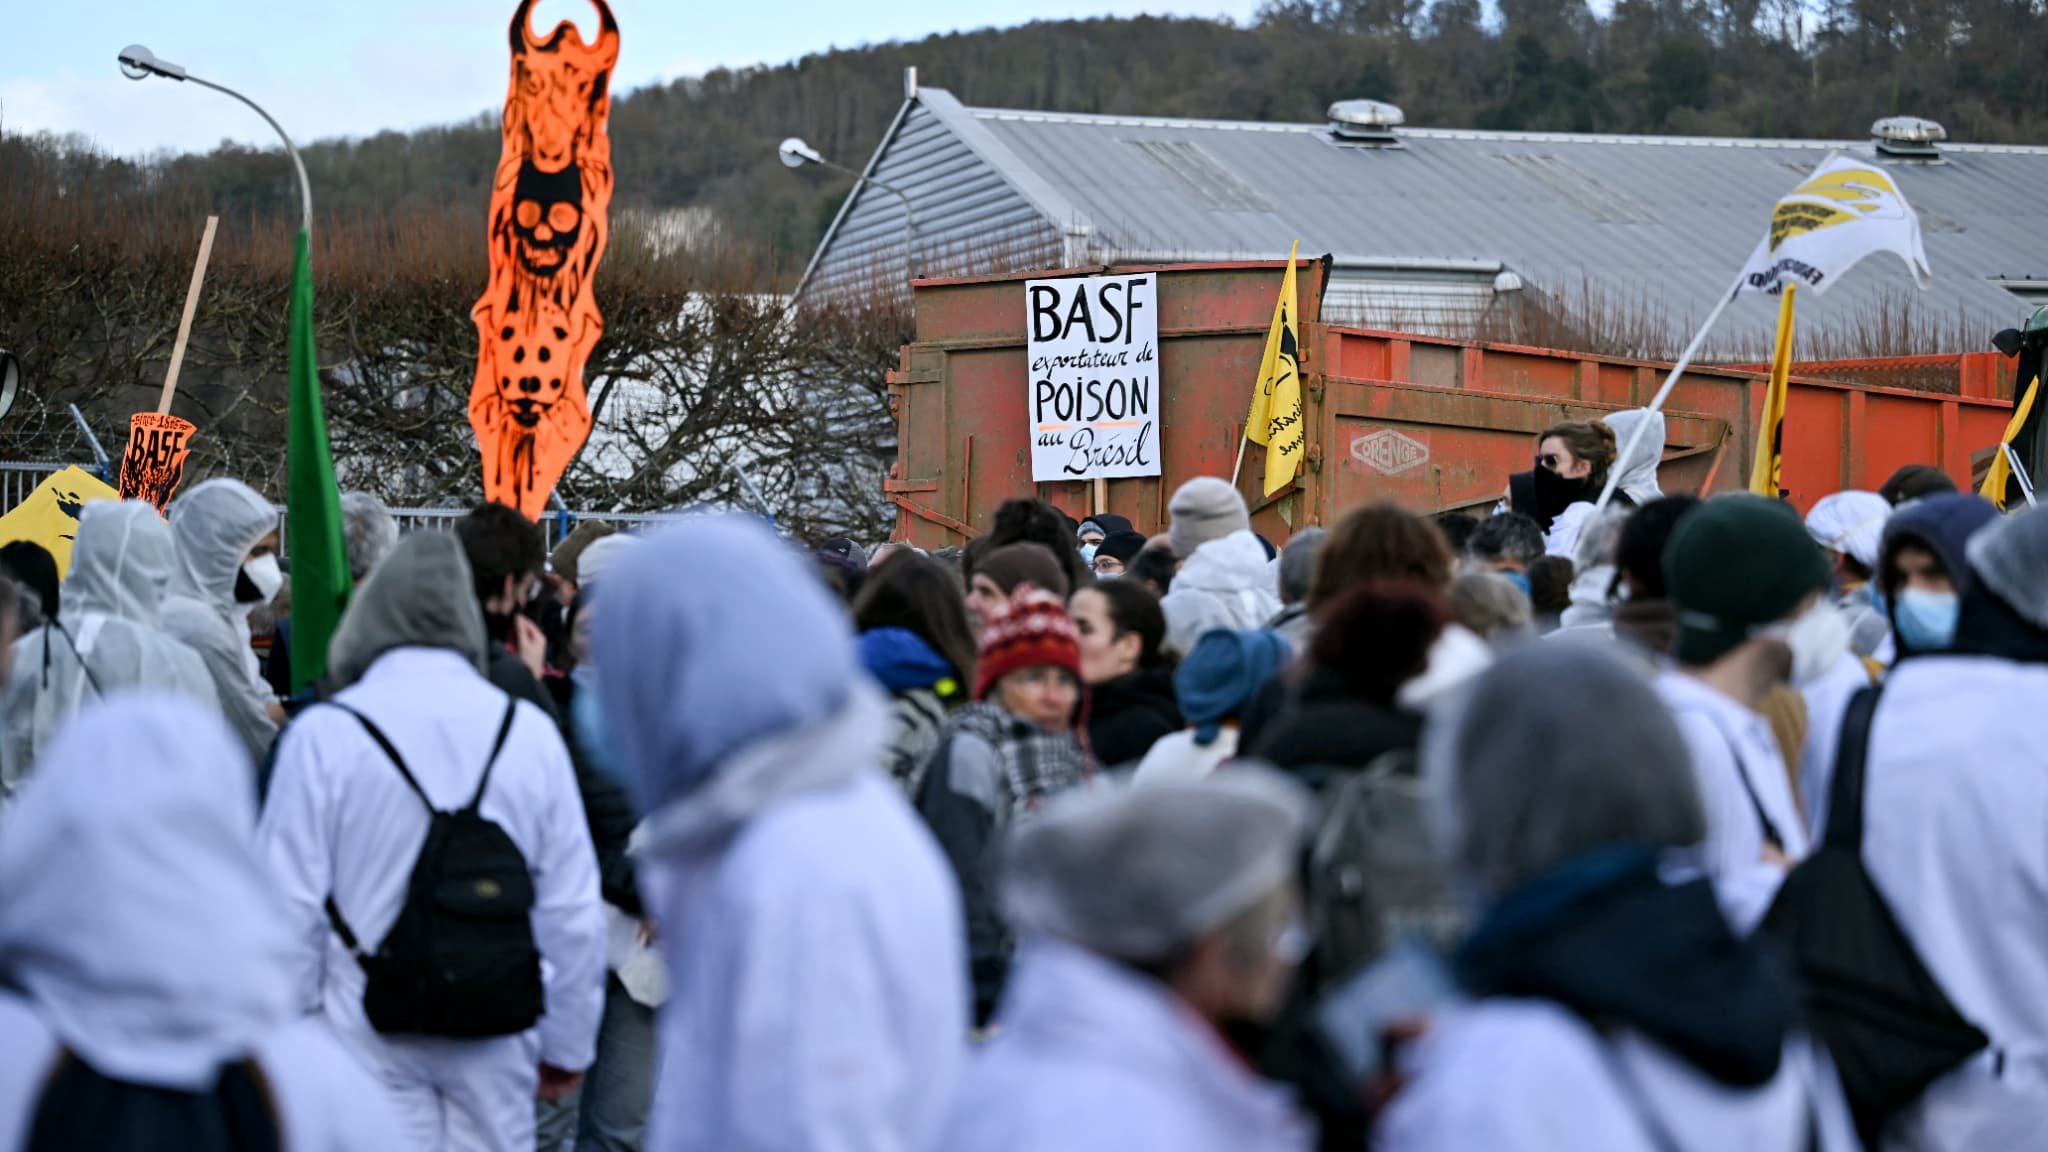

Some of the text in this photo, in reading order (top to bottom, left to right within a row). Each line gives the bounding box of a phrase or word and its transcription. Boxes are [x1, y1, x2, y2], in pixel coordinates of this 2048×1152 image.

[1029, 278, 1148, 345] BASF
[1032, 341, 1153, 380] exportateur de
[131, 426, 184, 471] BASF
[1037, 421, 1152, 475] au Brésil
